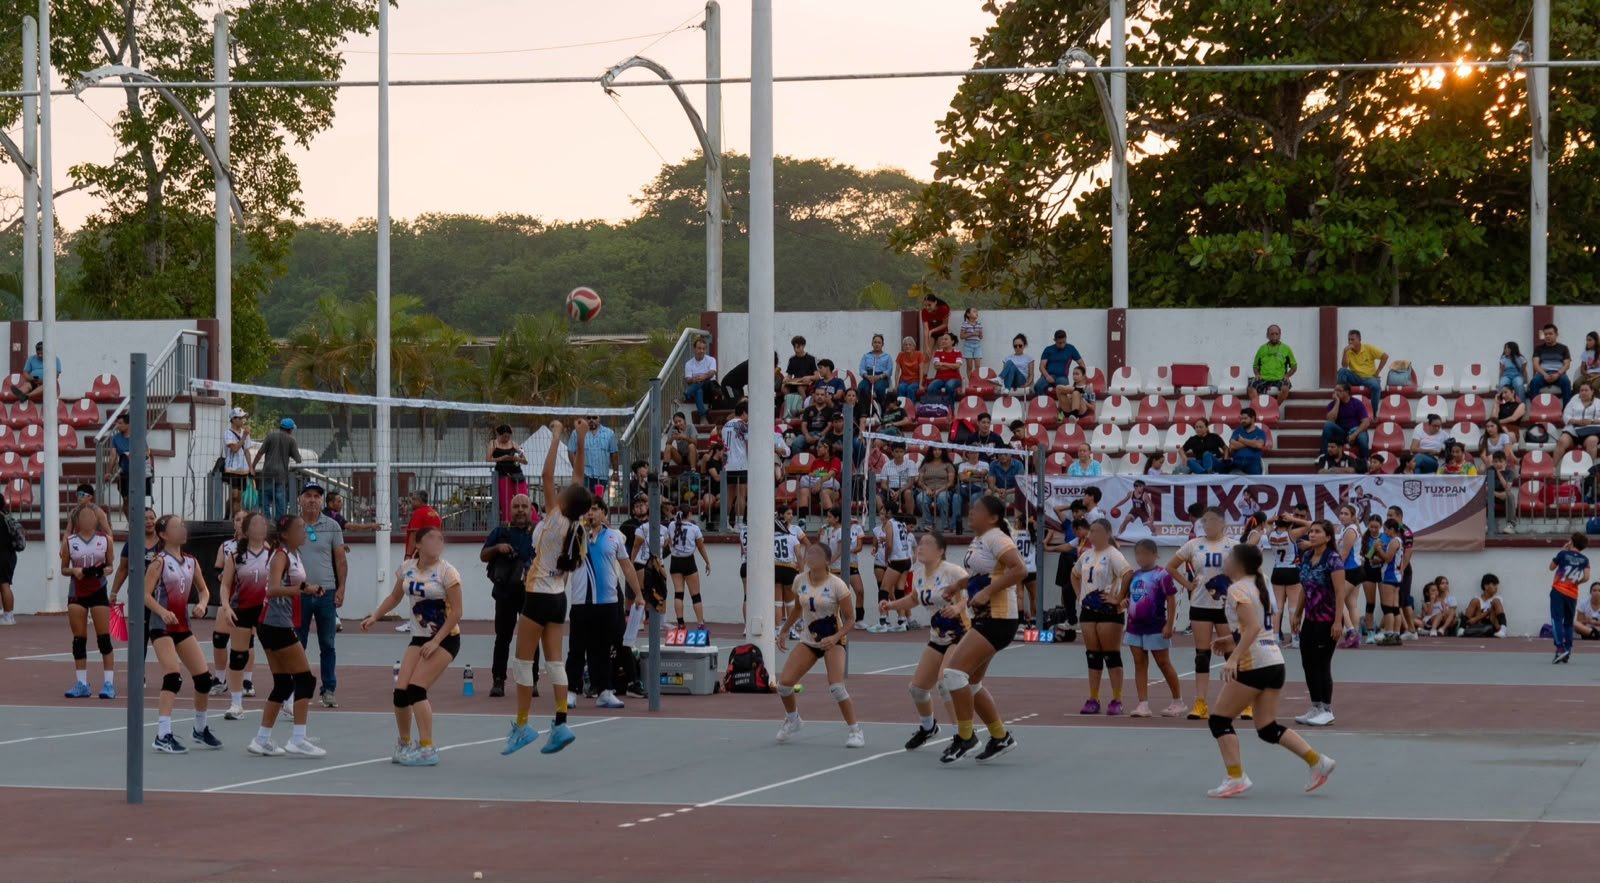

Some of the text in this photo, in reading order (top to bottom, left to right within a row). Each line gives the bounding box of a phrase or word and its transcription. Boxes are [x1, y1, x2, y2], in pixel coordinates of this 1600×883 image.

[1054, 487, 1088, 495] TUXPA
[1424, 486, 1466, 494] TUXPAN
[1145, 485, 1348, 521] TUXPAN
[774, 538, 789, 558] 35
[1277, 549, 1286, 562] 7
[1204, 553, 1222, 567] 10
[1087, 566, 1094, 583] 1
[180, 576, 186, 593] 5
[409, 581, 426, 597] 15
[809, 597, 816, 612] 1
[920, 589, 934, 606] 12
[667, 632, 706, 644] 29 22
[1026, 630, 1053, 641] 17 29
